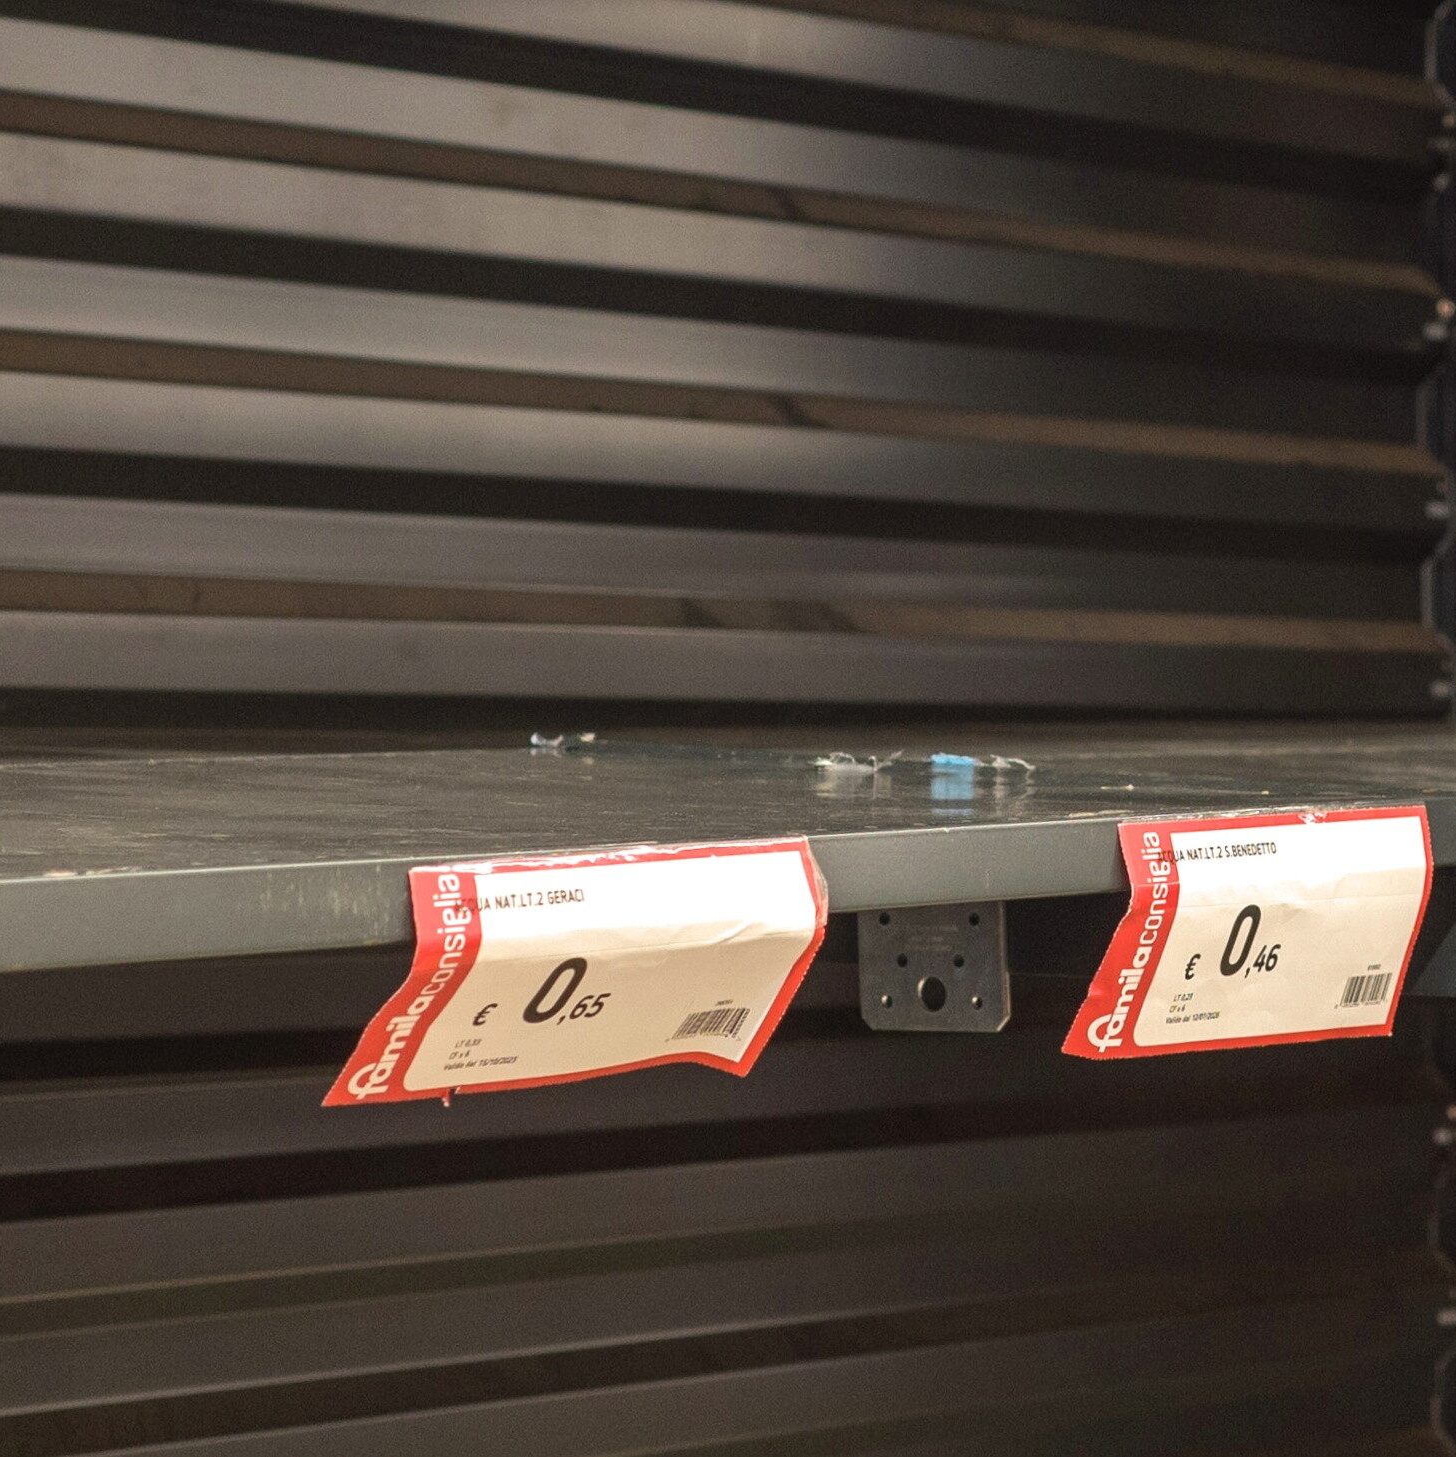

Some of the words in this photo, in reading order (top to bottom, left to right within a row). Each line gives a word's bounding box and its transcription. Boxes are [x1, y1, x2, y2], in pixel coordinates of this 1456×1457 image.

[1225, 841, 1277, 858] S.BENEDETTO
[547, 888, 585, 905] GERACI
[1184, 953, 1201, 981] €
[1219, 904, 1282, 979] 0,46
[473, 1002, 497, 1027] €
[522, 957, 612, 1026] 0,65
